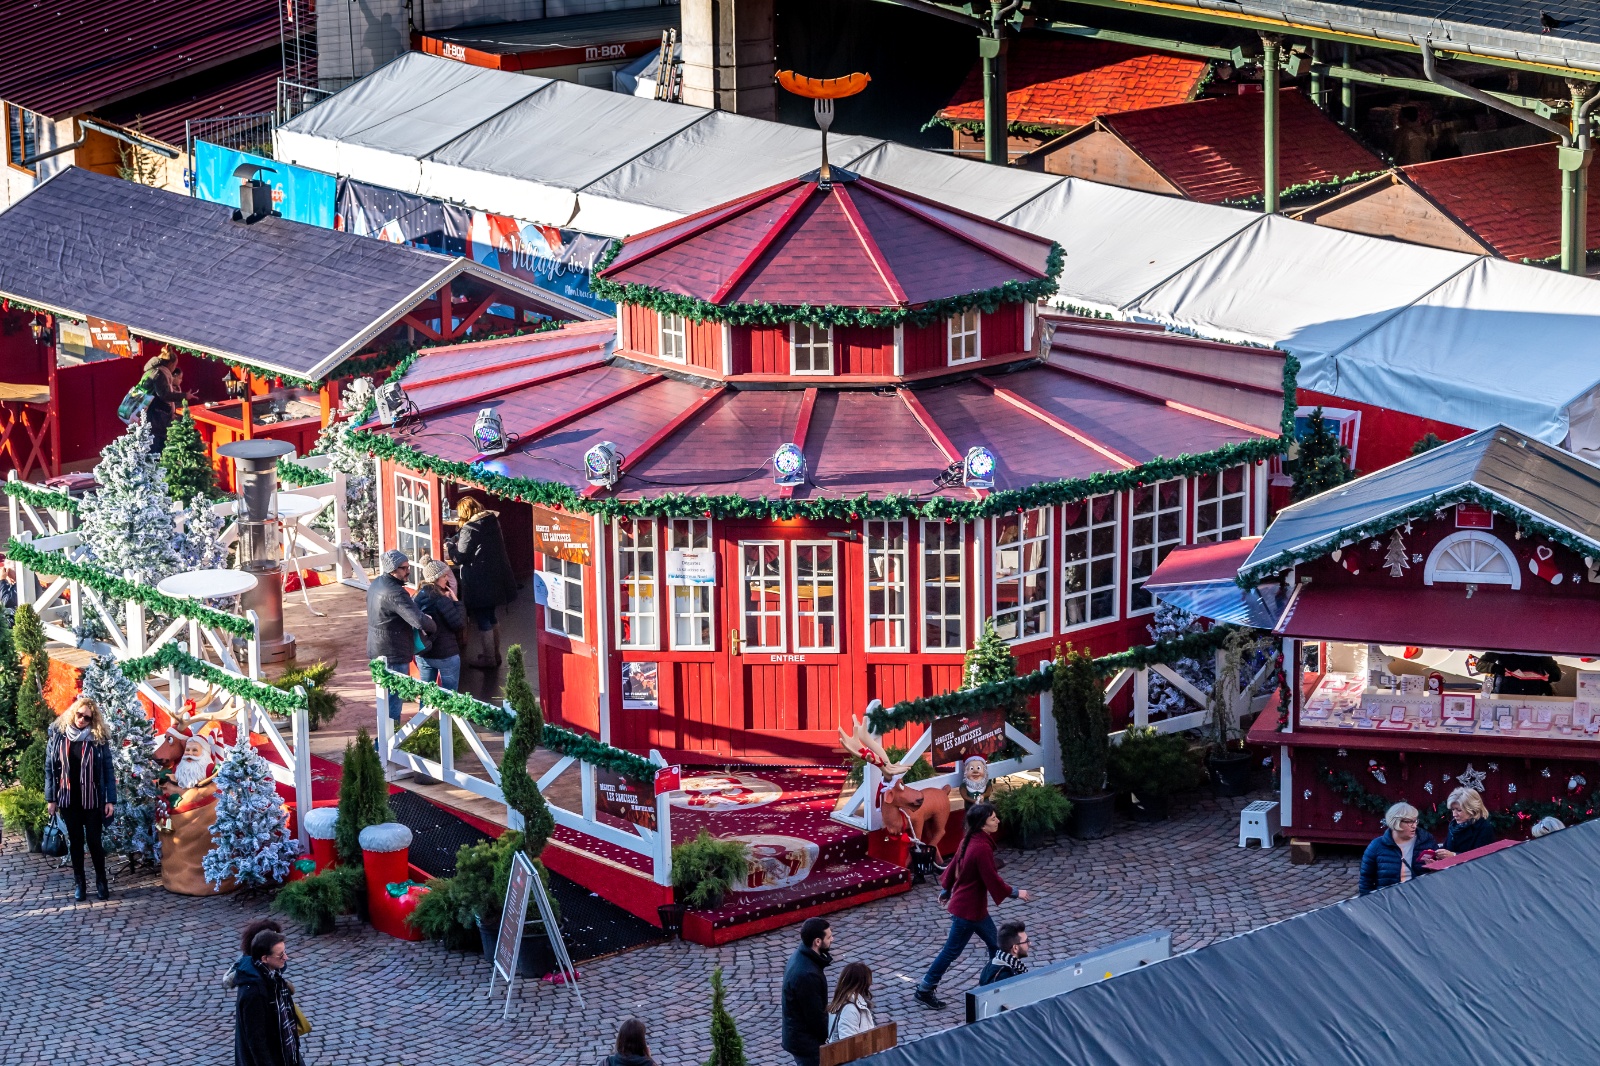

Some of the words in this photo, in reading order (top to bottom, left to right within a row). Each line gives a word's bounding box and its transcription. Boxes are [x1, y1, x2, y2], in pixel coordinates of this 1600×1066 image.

[510, 234, 566, 281] Village
[943, 739, 954, 752] LES
[953, 727, 983, 747] SAUCISSES
[788, 871, 862, 892] Christmas
